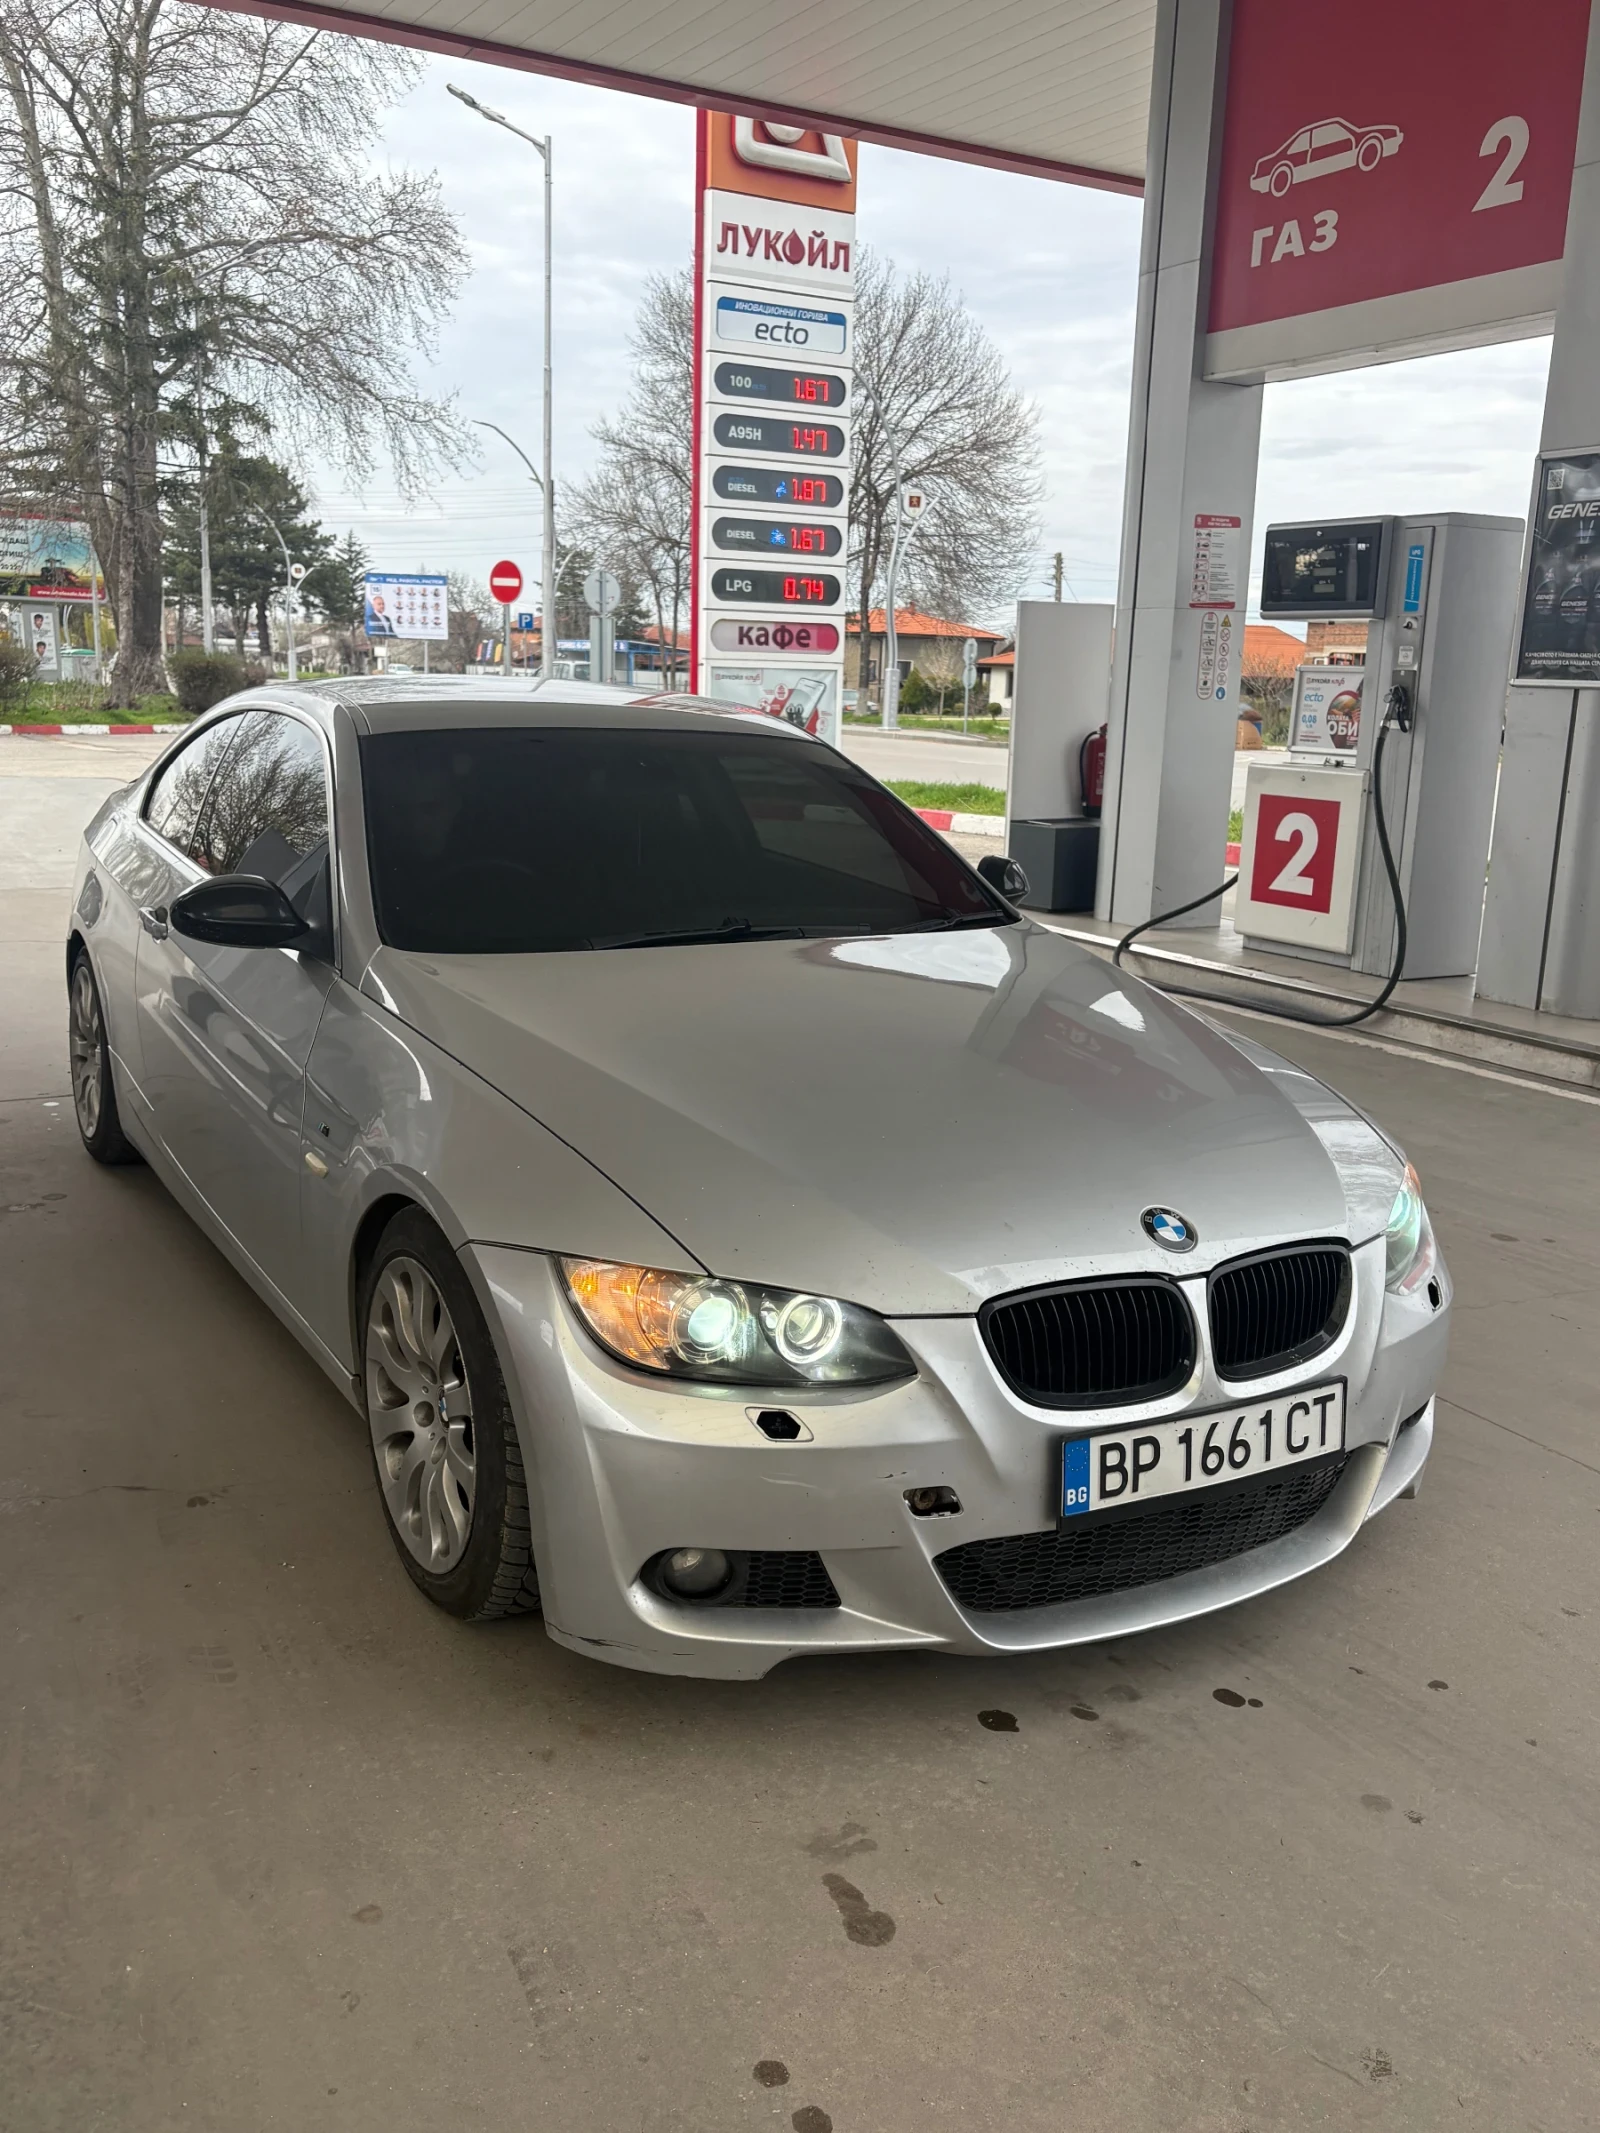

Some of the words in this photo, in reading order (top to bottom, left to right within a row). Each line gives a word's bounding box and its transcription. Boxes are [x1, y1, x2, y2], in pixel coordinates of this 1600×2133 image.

[1471, 115, 1530, 213] 2
[717, 221, 850, 272] ЛУКОЙЛ
[1250, 209, 1339, 268] ГАЗ
[735, 301, 797, 318] ИНОВАЦИОННИ
[797, 311, 829, 322] ГОРИВА
[755, 321, 809, 345] ecto
[730, 375, 752, 388] 100
[793, 378, 829, 402] 1.67
[792, 426, 828, 451] 1.47
[727, 482, 757, 494] DIESEL
[792, 477, 827, 503] 1.87
[1548, 501, 1600, 520] GENE
[726, 529, 756, 541] DIESEL
[791, 527, 825, 551] 1.67
[725, 578, 753, 593] LPG
[783, 577, 824, 601] 0.74
[521, 615, 530, 627] P
[738, 625, 811, 648] кафе
[1304, 692, 1324, 702] ecto
[1268, 811, 1319, 897] 2
[1099, 1434, 1161, 1501] BP
[1178, 1408, 1274, 1482] 1661
[1286, 1392, 1336, 1454] CT
[1066, 1486, 1088, 1505] BG
